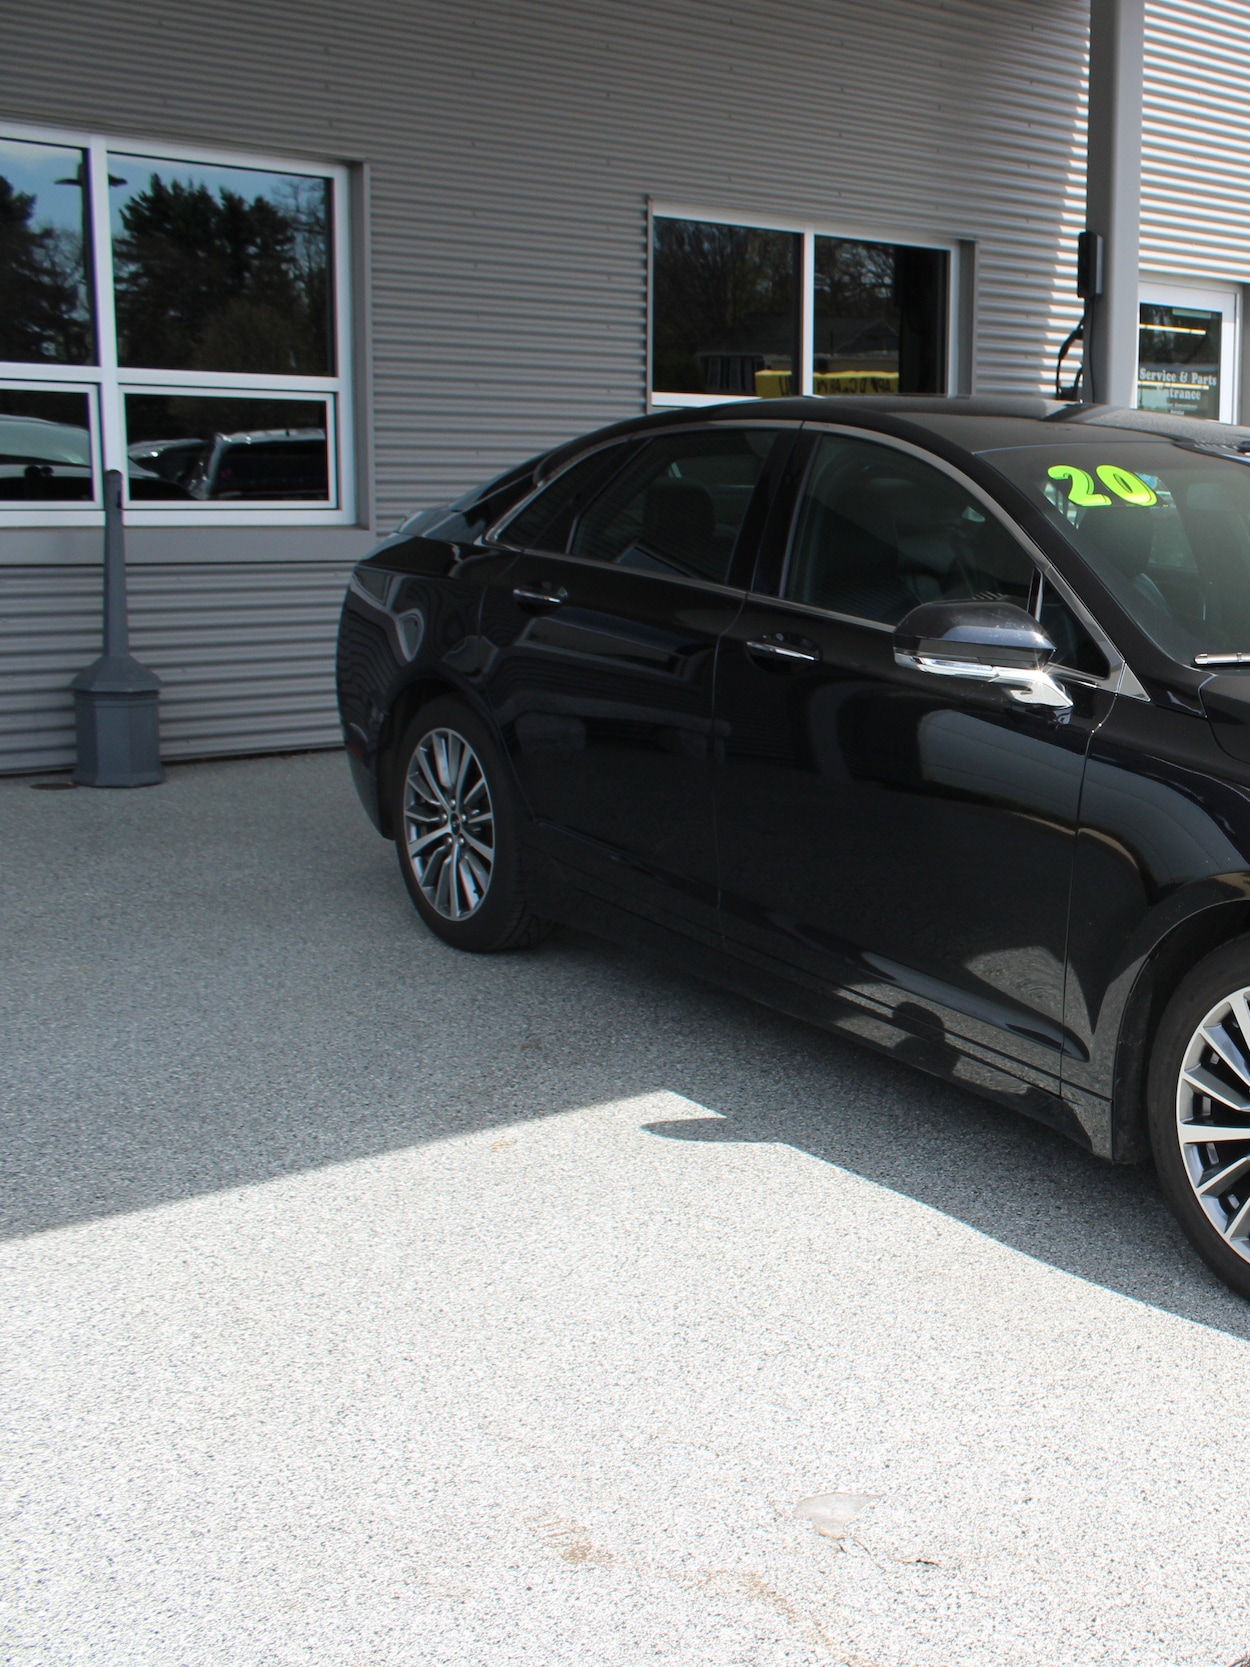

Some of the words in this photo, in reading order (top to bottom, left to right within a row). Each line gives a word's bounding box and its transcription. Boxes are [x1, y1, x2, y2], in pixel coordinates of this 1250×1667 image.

[1140, 367, 1177, 382] Service
[1180, 371, 1189, 383] &
[1191, 372, 1217, 386] Parts
[1047, 464, 1157, 507] 20
